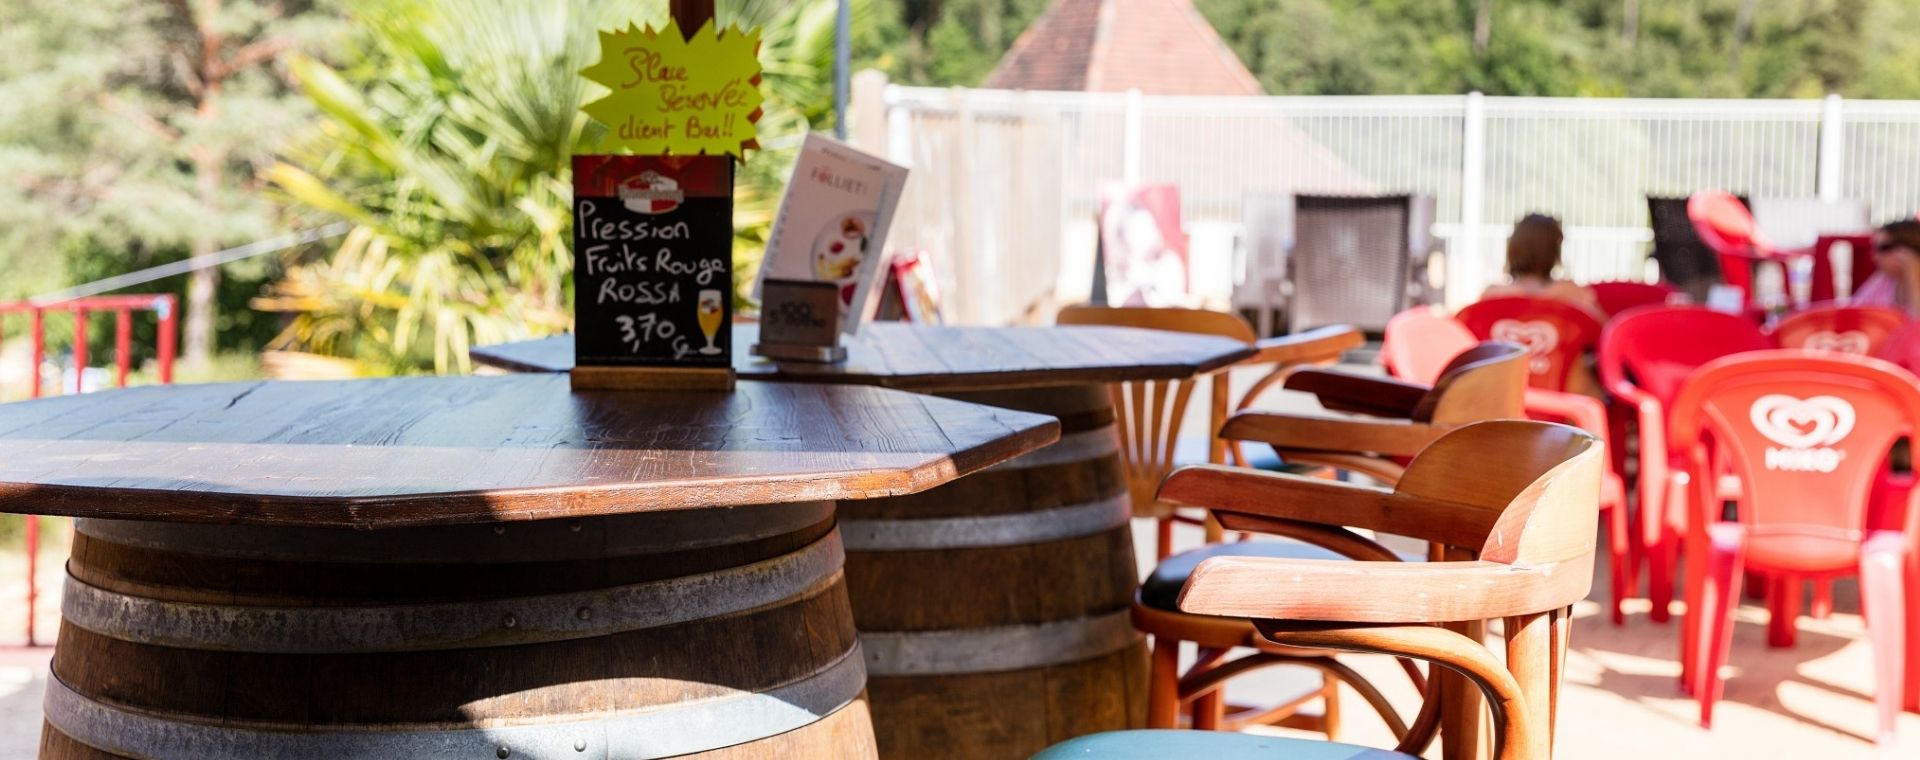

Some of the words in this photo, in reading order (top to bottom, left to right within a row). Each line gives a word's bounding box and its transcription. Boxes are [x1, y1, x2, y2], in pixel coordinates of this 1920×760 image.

[618, 114, 675, 140] client
[578, 199, 690, 241] Pression
[585, 244, 648, 276] Fruits
[655, 247, 727, 286] Rouge
[597, 277, 681, 304] ROSSA
